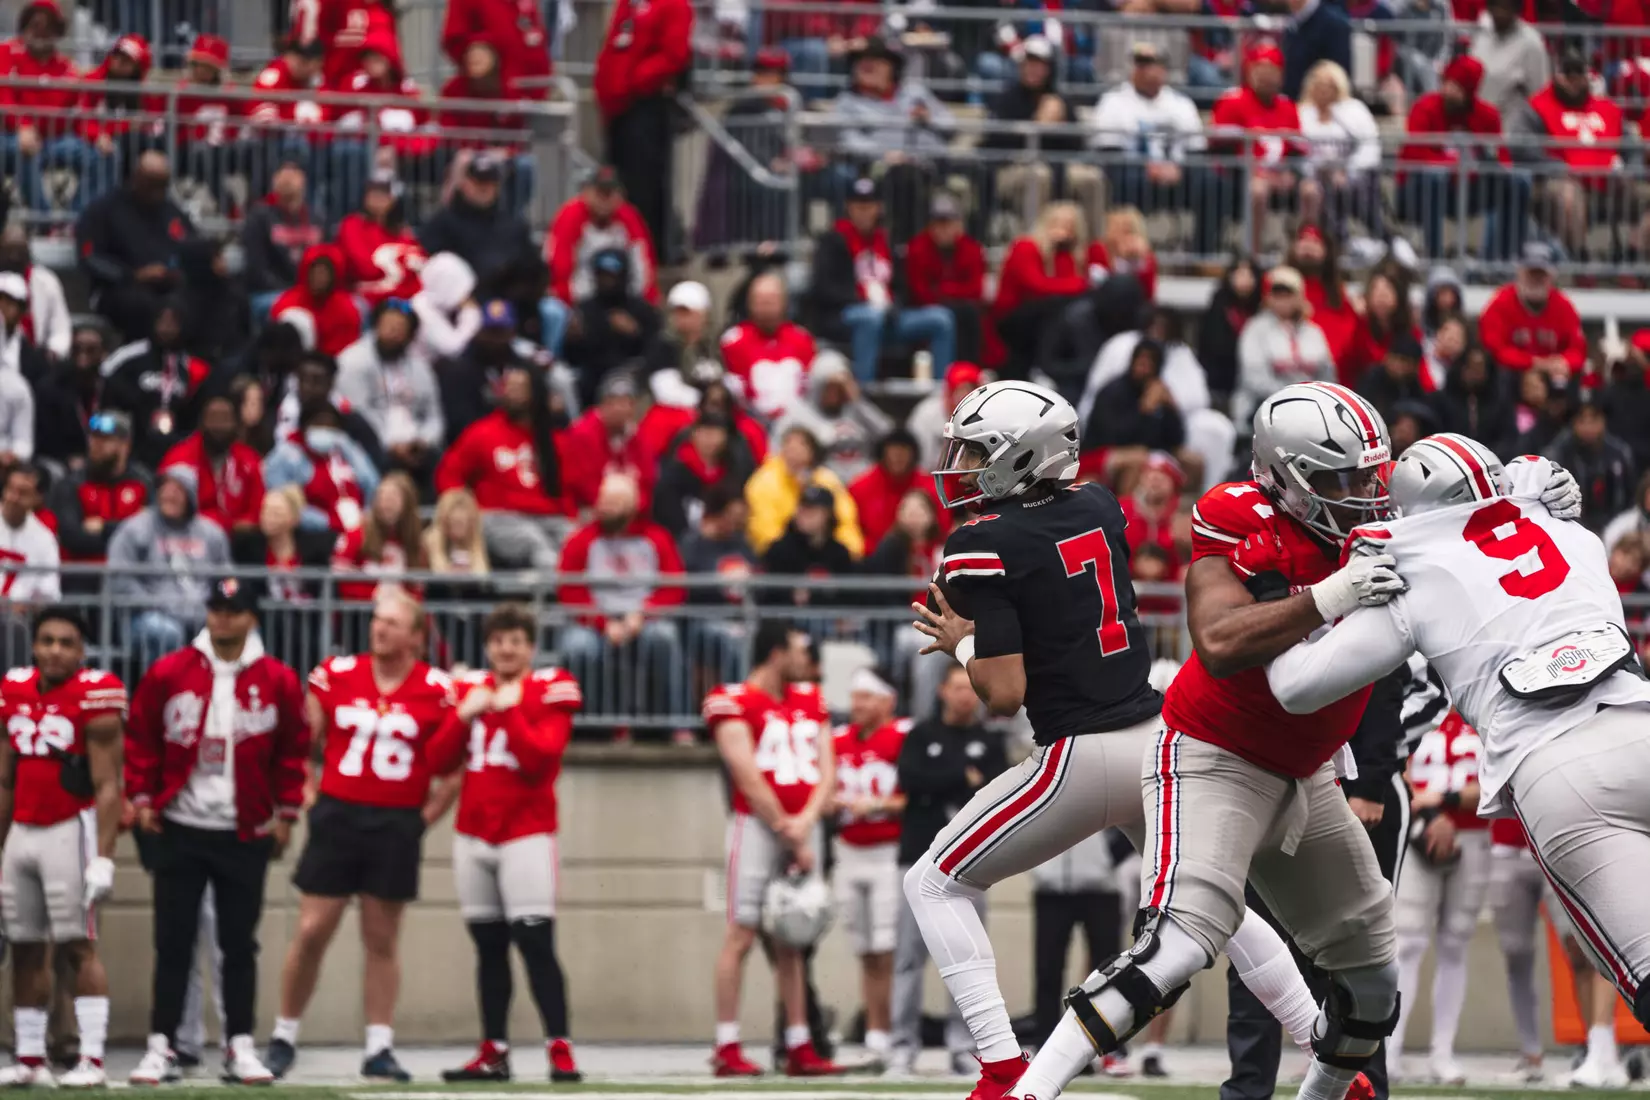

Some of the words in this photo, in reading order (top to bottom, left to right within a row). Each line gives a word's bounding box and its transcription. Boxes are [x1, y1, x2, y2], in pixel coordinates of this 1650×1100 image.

[1363, 451, 1389, 464] Riddell
[1055, 527, 1130, 657] 7
[1462, 498, 1571, 600] 9
[335, 704, 418, 781] 76
